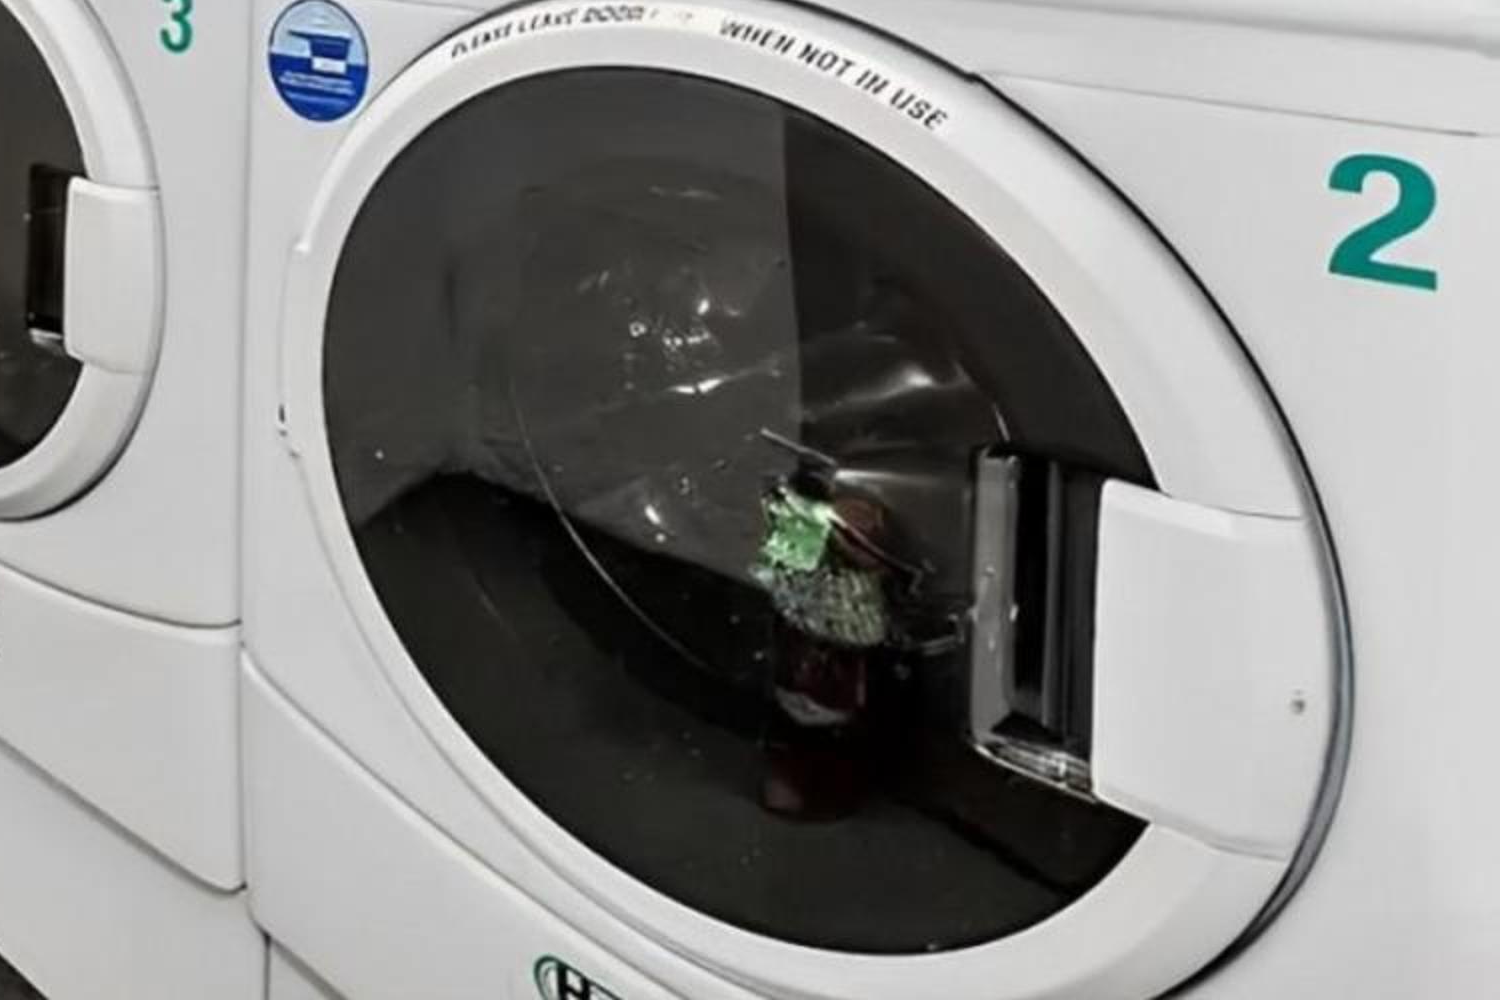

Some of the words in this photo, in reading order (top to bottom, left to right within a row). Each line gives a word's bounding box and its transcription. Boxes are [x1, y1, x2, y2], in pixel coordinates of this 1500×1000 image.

[720, 19, 797, 55] WHEN
[797, 42, 855, 78] NOT
[854, 68, 889, 96] IN
[889, 87, 949, 131] USE
[1328, 153, 1438, 292] 2
